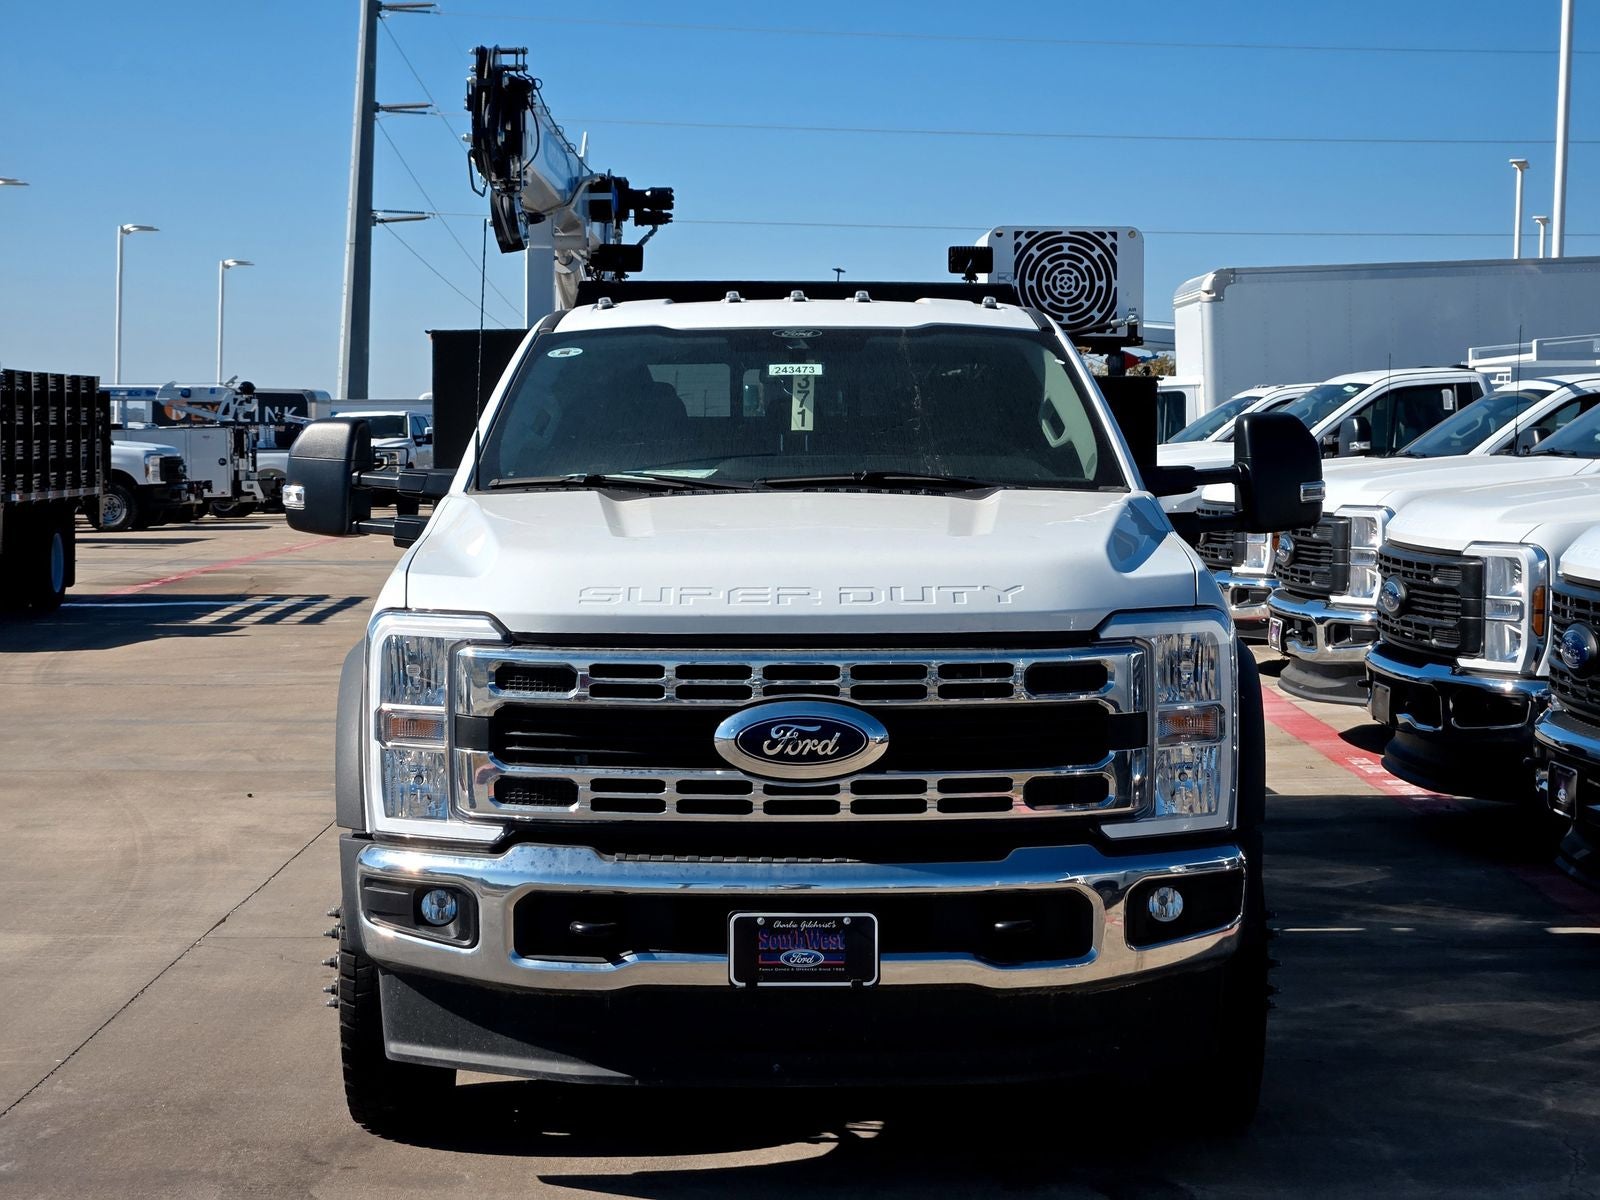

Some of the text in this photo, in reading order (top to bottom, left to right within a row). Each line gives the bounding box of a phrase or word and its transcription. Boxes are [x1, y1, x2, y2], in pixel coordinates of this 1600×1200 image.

[774, 366, 816, 374] 243473
[578, 584, 1026, 606] SUPER DUTY
[763, 723, 840, 756] Ford
[773, 920, 799, 929] Charlie
[789, 952, 815, 964] Ford
